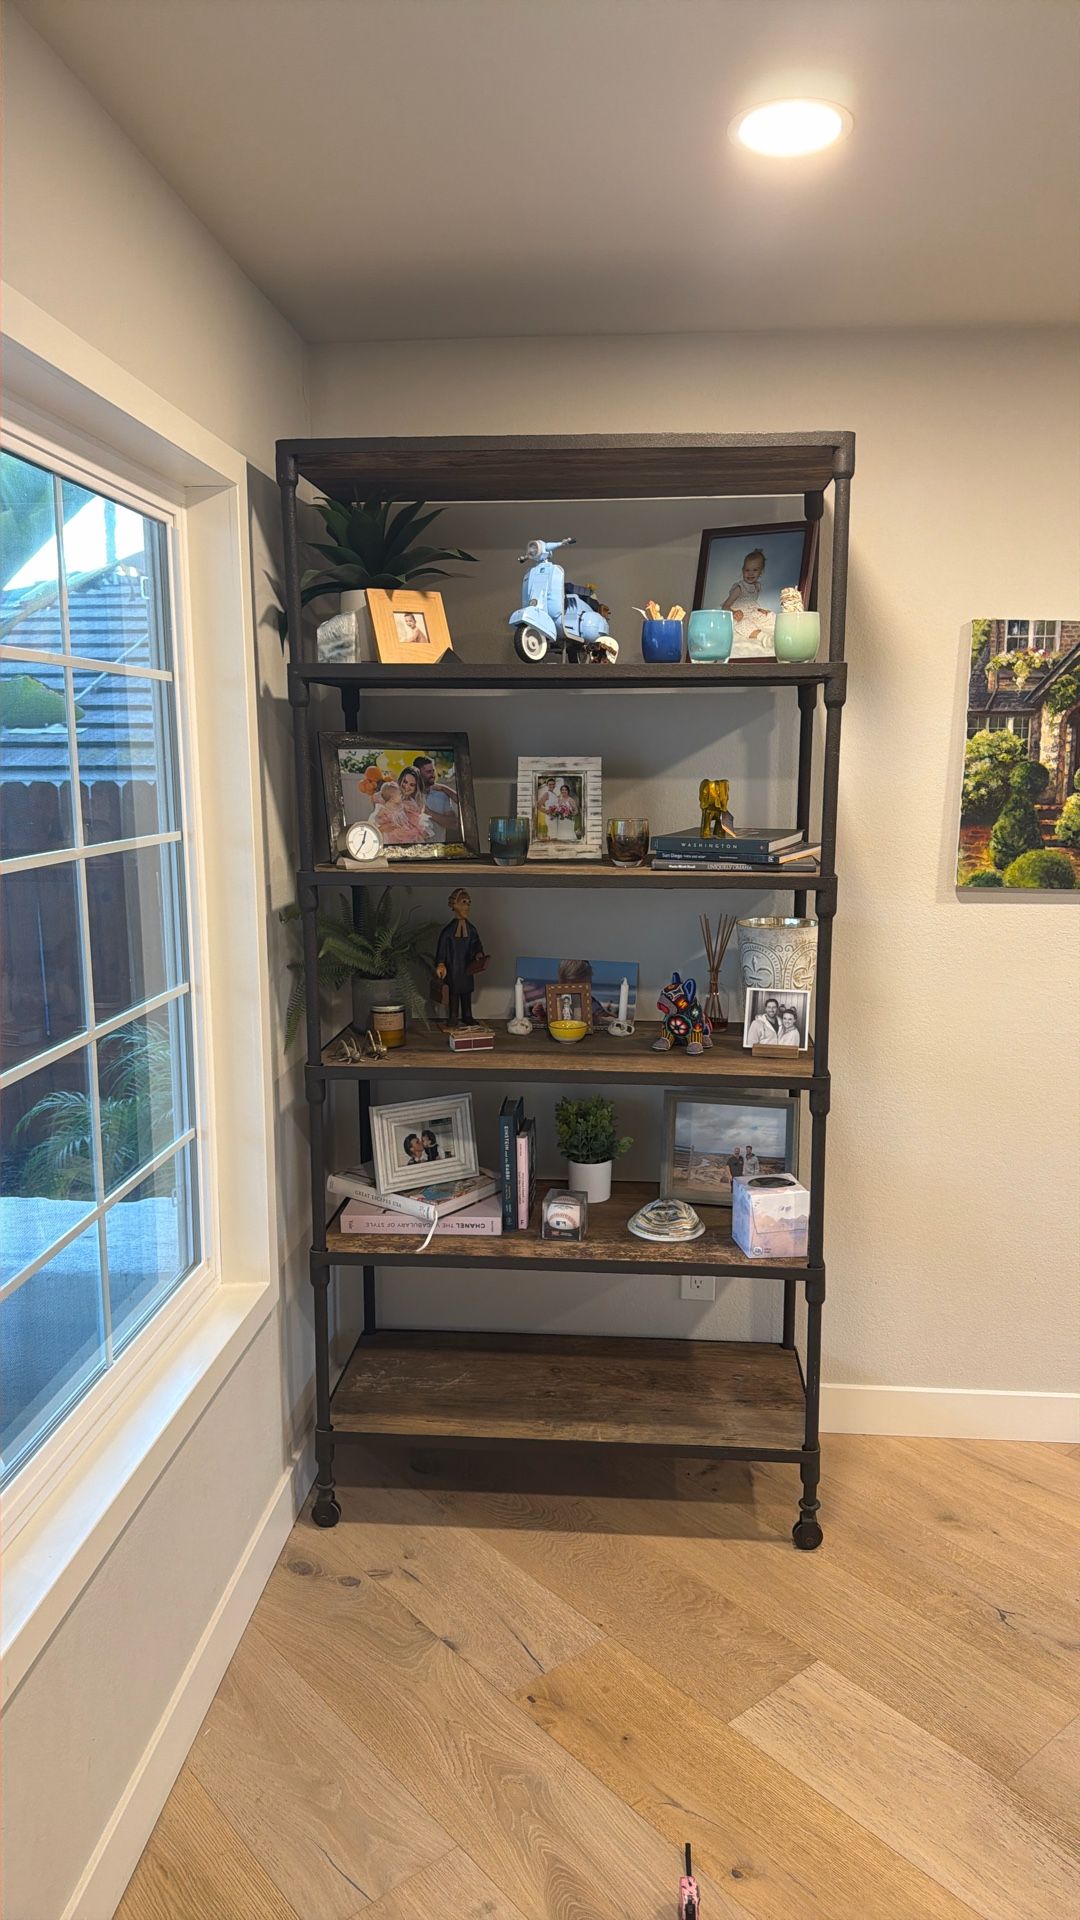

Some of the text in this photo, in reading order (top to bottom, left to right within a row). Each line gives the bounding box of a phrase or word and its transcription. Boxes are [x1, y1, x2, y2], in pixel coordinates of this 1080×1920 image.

[354, 1190, 402, 1209] GREAT ESCAPES USA
